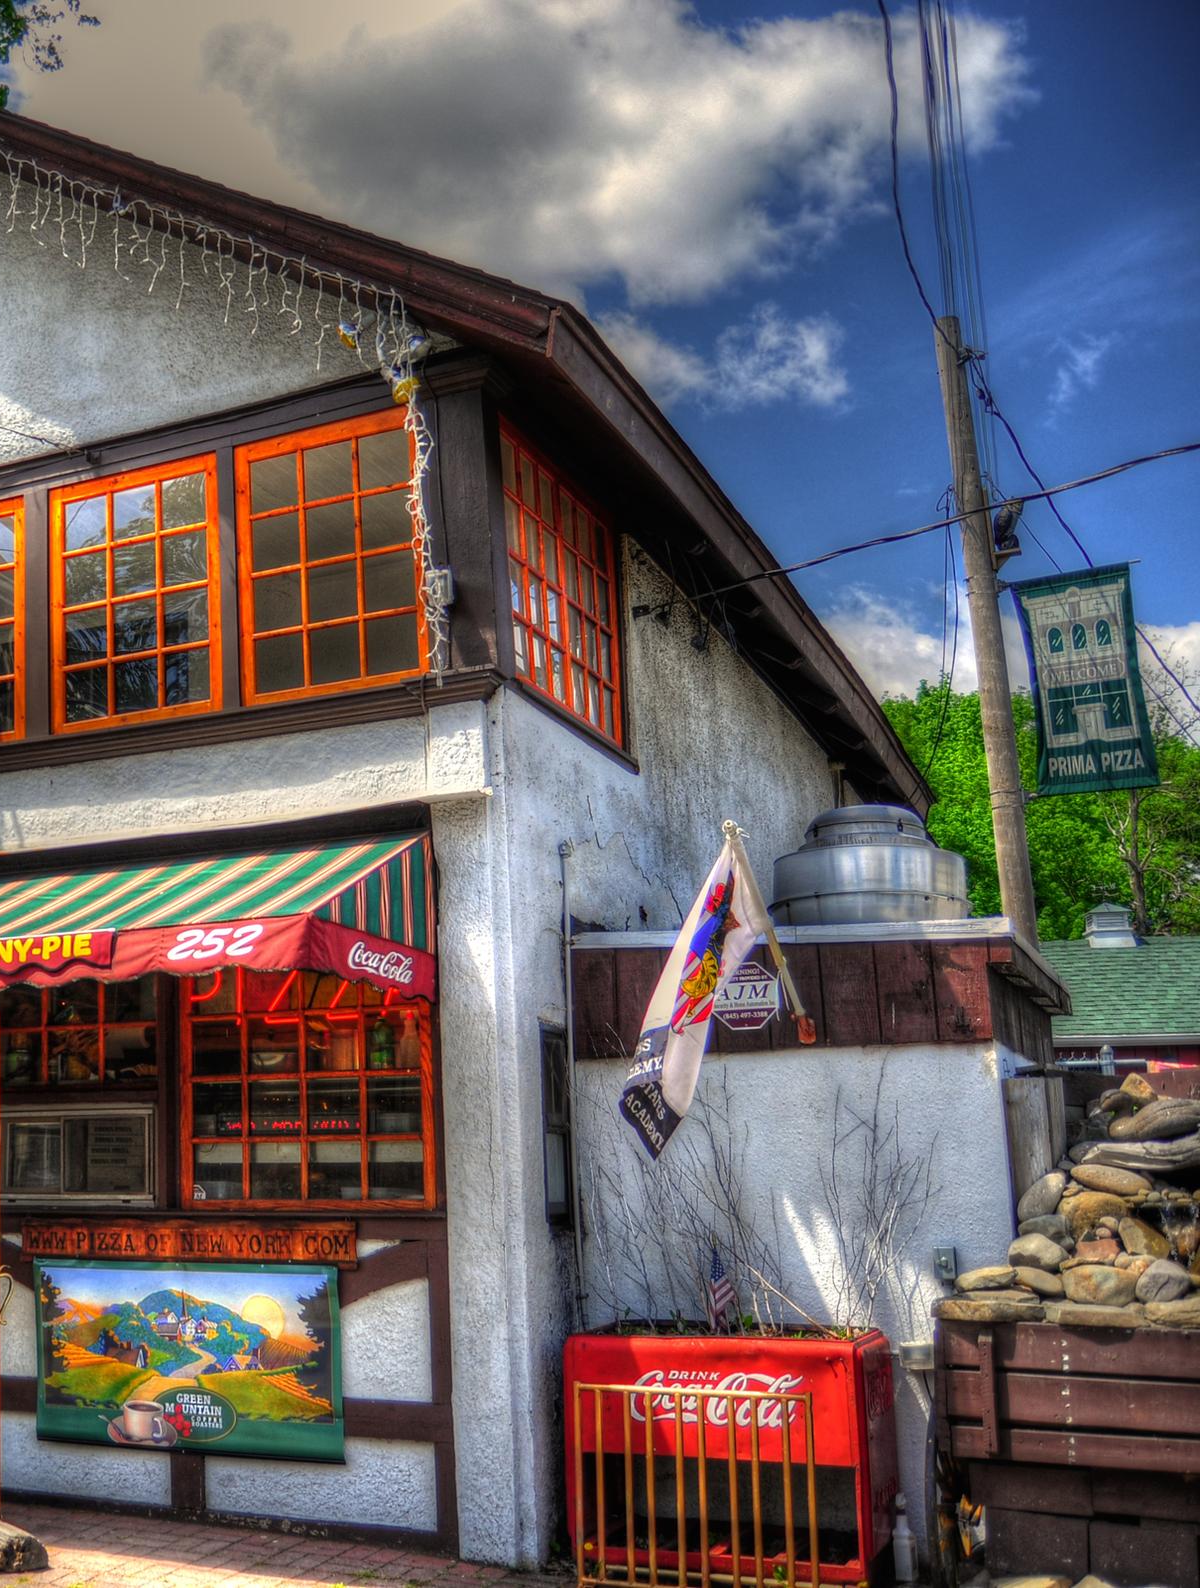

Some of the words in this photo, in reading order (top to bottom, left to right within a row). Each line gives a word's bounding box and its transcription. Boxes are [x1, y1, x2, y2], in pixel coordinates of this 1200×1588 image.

[1051, 662, 1118, 682] WELCOME
[1049, 754, 1096, 778] PRIMA
[1102, 748, 1145, 773] PIZZA
[167, 924, 264, 961] 252
[719, 983, 770, 1001] AJM
[75, 1232, 135, 1252] PIZZA
[146, 1233, 170, 1252] OF
[181, 1232, 223, 1253] NEW
[235, 1233, 292, 1254] YORK
[304, 1234, 350, 1256] COM
[667, 1369, 721, 1381] DRINK
[176, 1393, 211, 1405] GREEN
[165, 1402, 222, 1416] MOUNTAIN
[191, 1415, 223, 1425] COFFEE
[191, 1421, 223, 1429] ROASTERS
